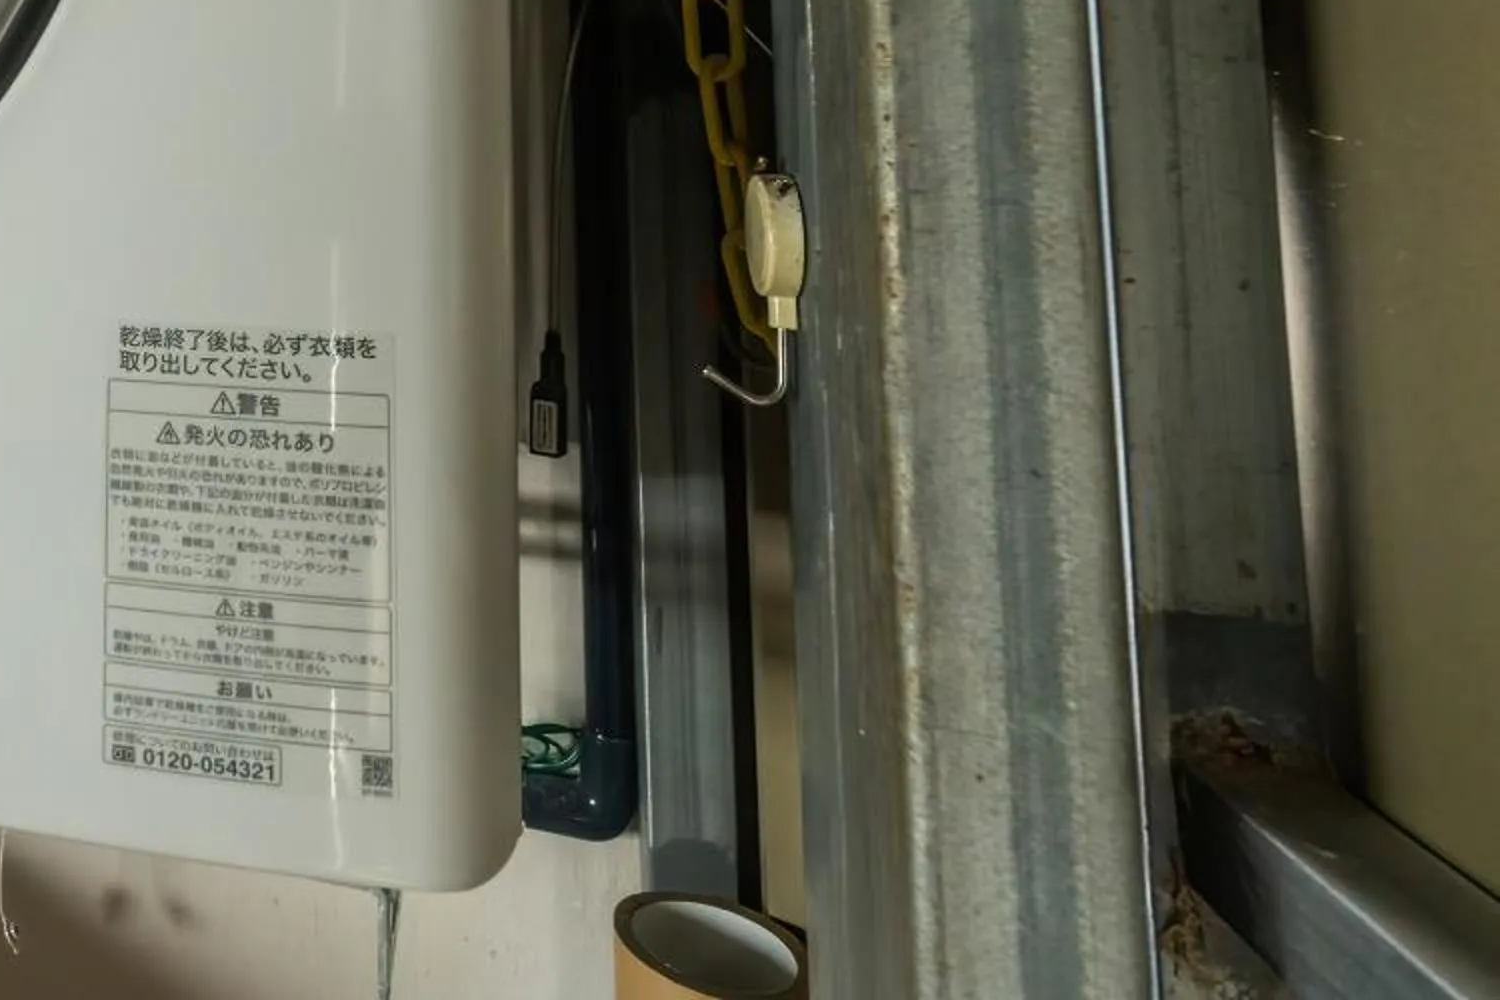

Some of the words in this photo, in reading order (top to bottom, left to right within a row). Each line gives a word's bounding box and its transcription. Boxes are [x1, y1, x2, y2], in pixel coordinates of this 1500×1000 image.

[119, 325, 377, 360] 乾燥終了後は、必ず衣類を
[119, 350, 312, 383] 取り出してください。
[238, 393, 280, 417] 警告
[185, 424, 336, 454] 発火の恐れあり
[217, 680, 273, 699] お願い
[143, 748, 276, 782] 0120-054321
